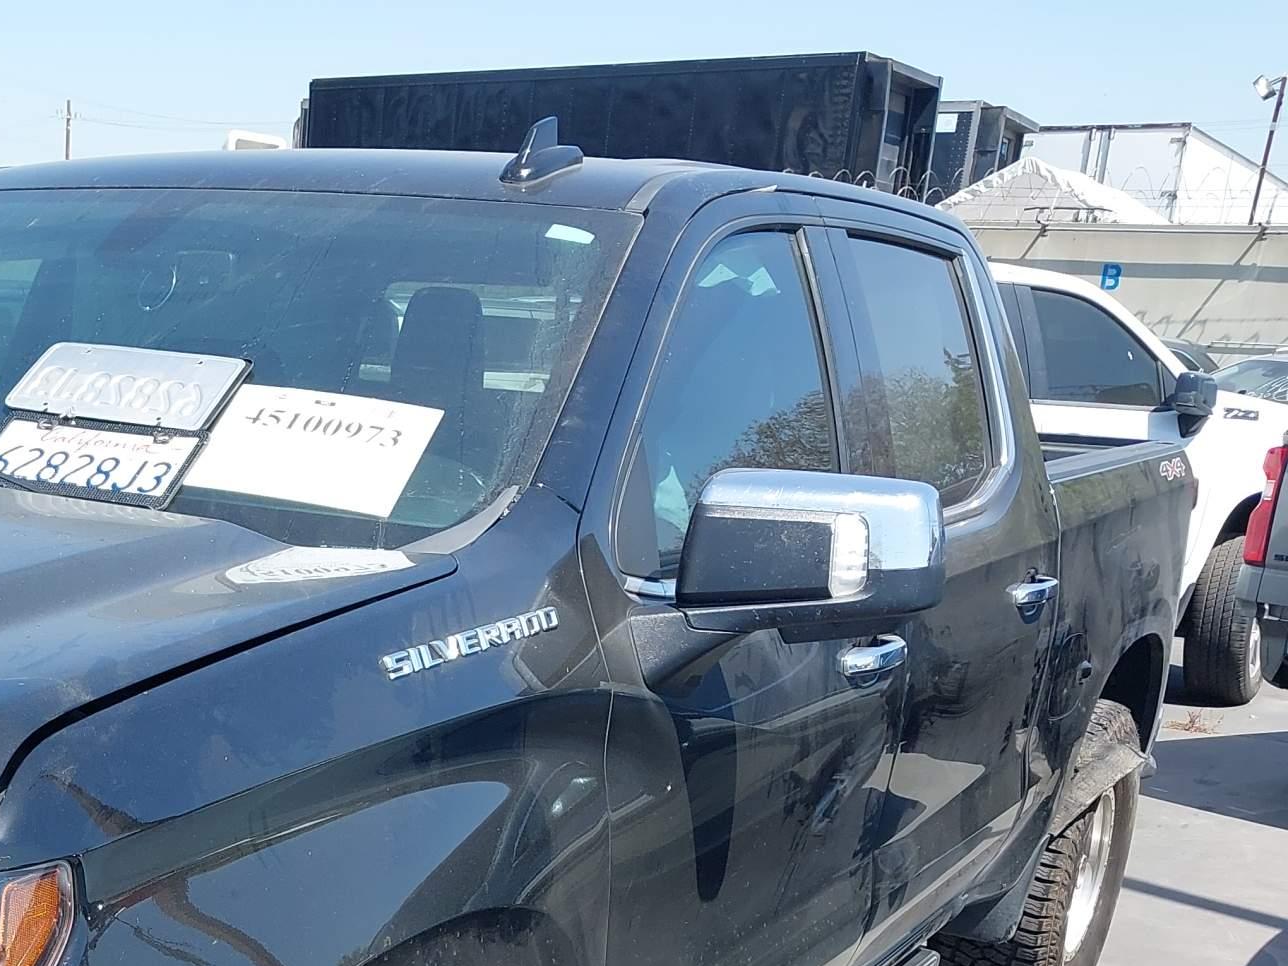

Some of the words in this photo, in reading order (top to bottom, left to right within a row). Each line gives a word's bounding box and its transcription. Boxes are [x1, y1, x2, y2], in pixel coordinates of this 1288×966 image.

[1100, 263, 1123, 290] B
[40, 426, 159, 454] California
[245, 407, 403, 448] 45100973
[380, 605, 560, 681] SILVERADO
